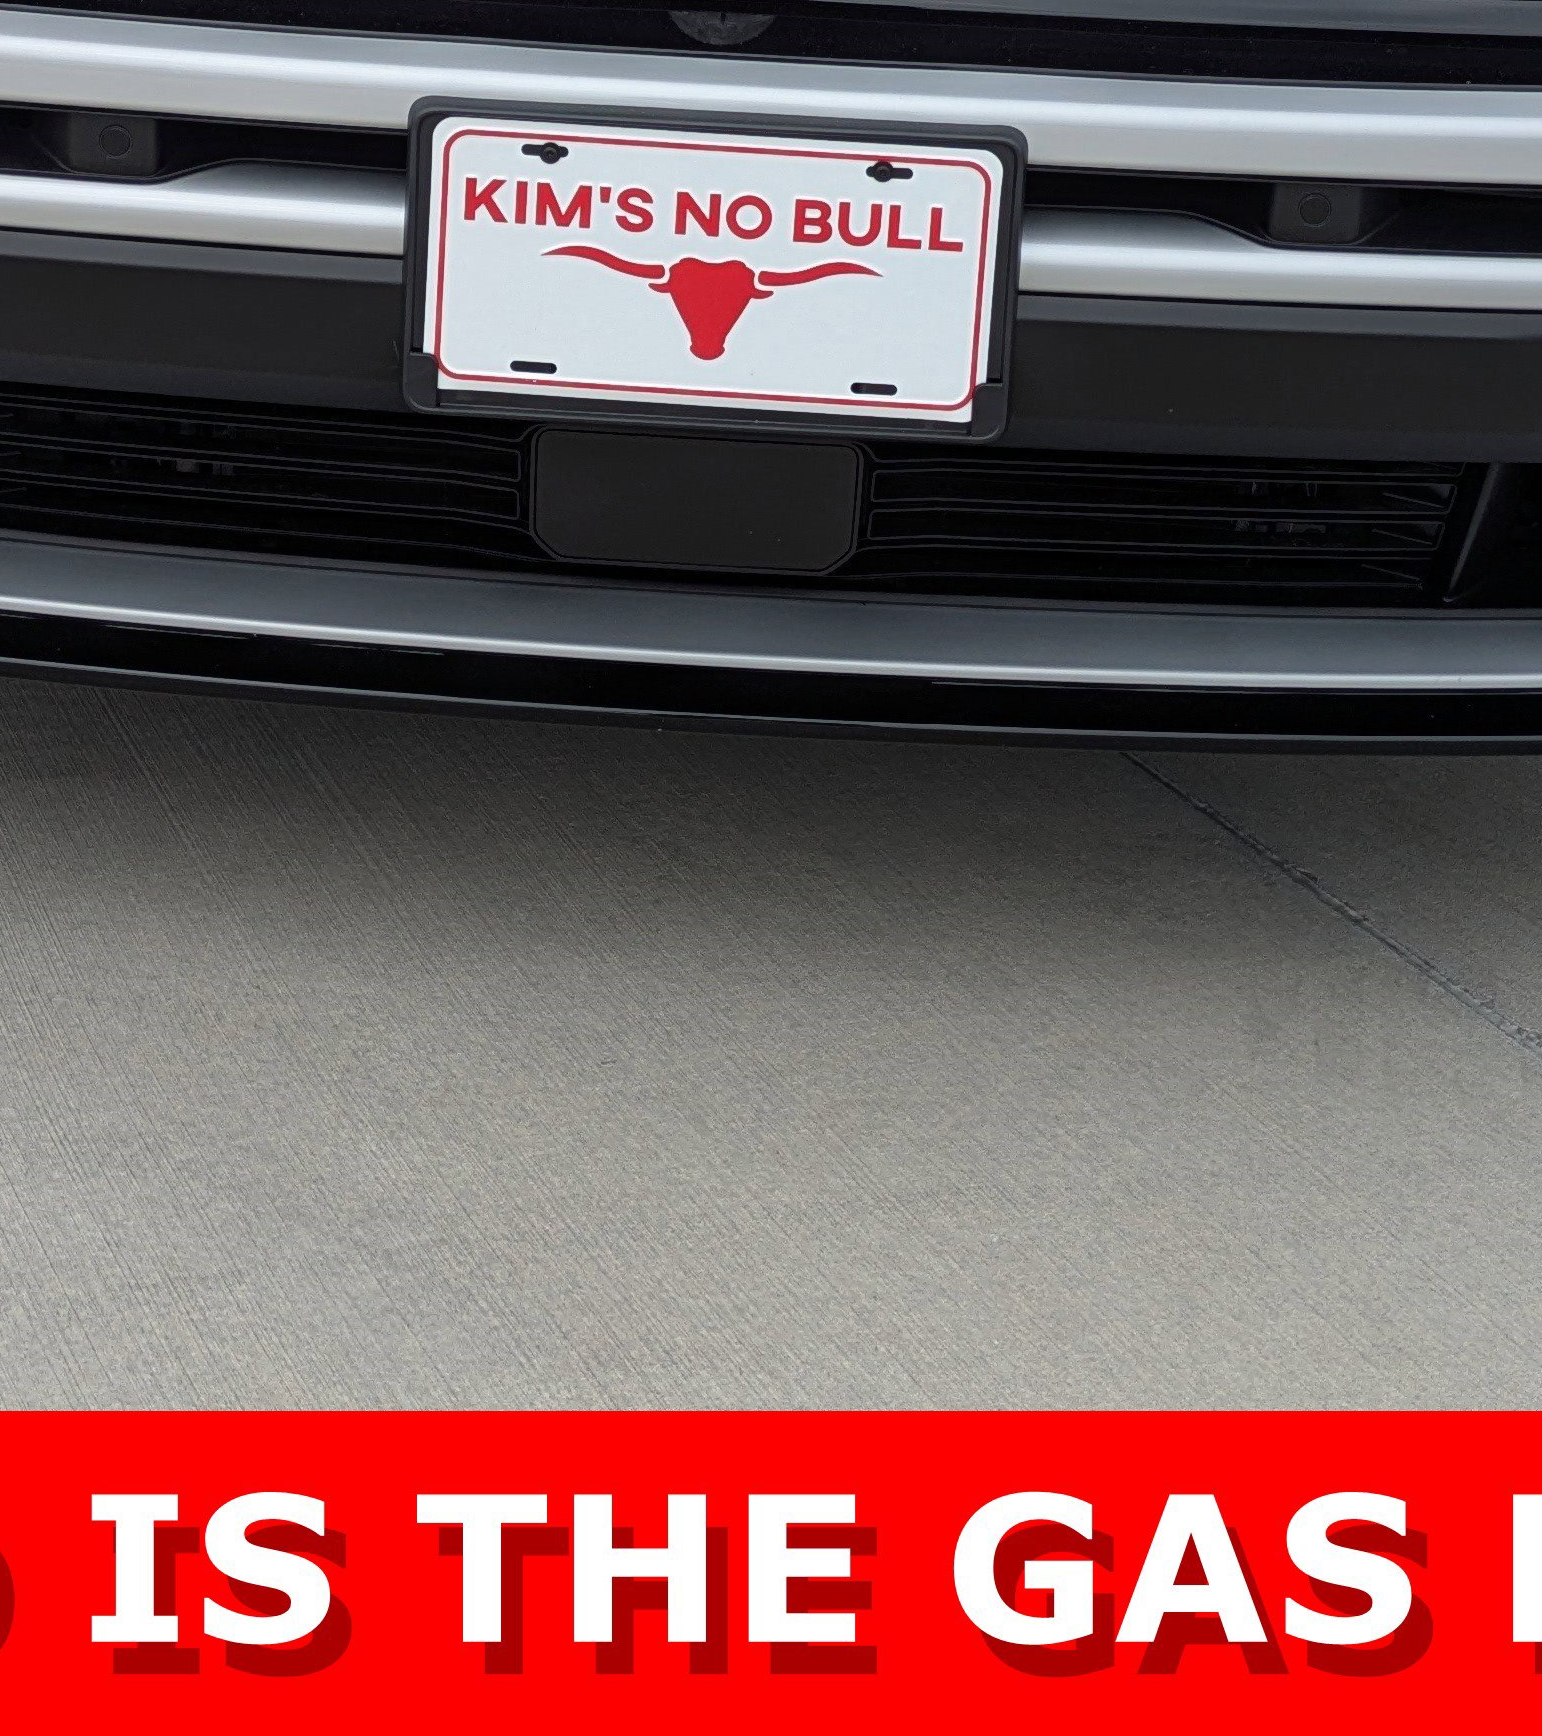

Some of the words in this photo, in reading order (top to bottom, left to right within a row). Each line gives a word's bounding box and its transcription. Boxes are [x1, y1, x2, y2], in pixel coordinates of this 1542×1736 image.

[463, 176, 655, 234] KIM'S
[674, 190, 774, 241] NO
[792, 198, 965, 253] BULL
